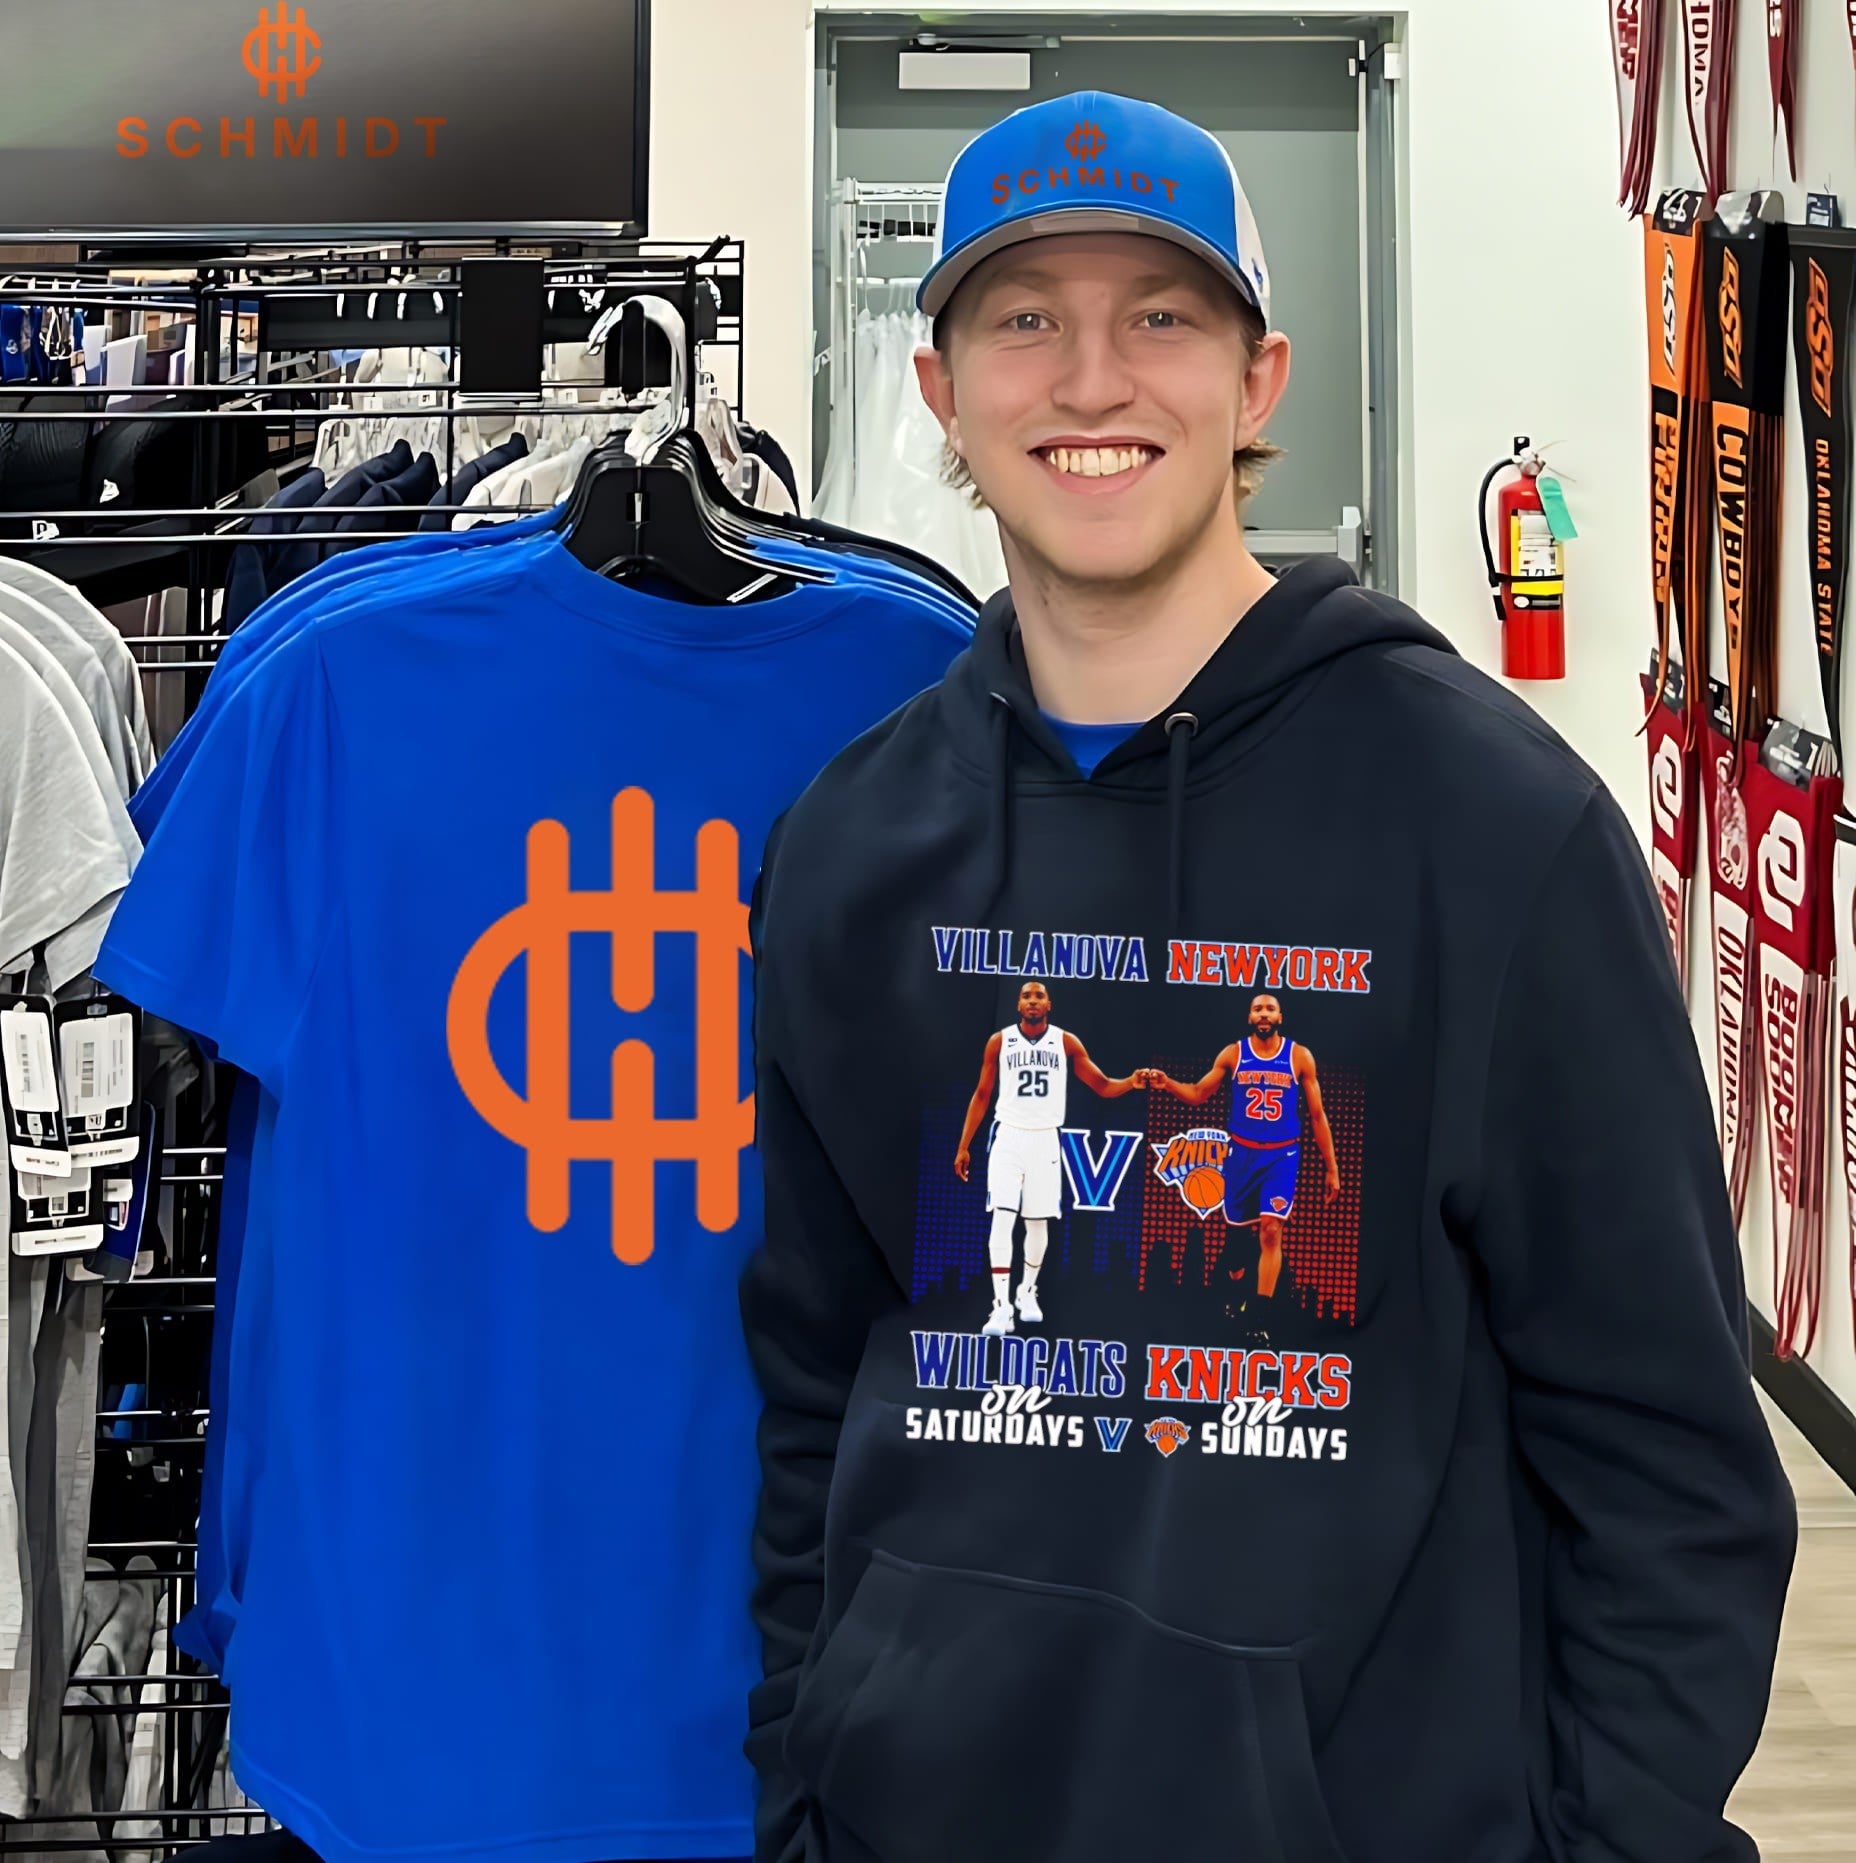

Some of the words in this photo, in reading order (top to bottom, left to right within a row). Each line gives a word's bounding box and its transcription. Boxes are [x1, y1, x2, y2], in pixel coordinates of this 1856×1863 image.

[115, 116, 448, 159] SCHMIDT
[991, 166, 1180, 204] SCHMIDT
[931, 926, 1149, 983] VILLANOVA
[1007, 1049, 1060, 1071] VILLANOVA
[1017, 1069, 1050, 1098] 25
[1245, 1087, 1284, 1121] 25
[1060, 1127, 1143, 1211] V
[1159, 1137, 1229, 1172] KNICK
[910, 1330, 1128, 1398] WILDCATS
[1144, 1344, 1353, 1410] KNICKS
[981, 1384, 1052, 1417] on
[1221, 1396, 1293, 1428] on
[905, 1408, 1084, 1448] SATURDAYS
[1093, 1416, 1133, 1453] V
[1201, 1422, 1348, 1461] SUNDAYS
